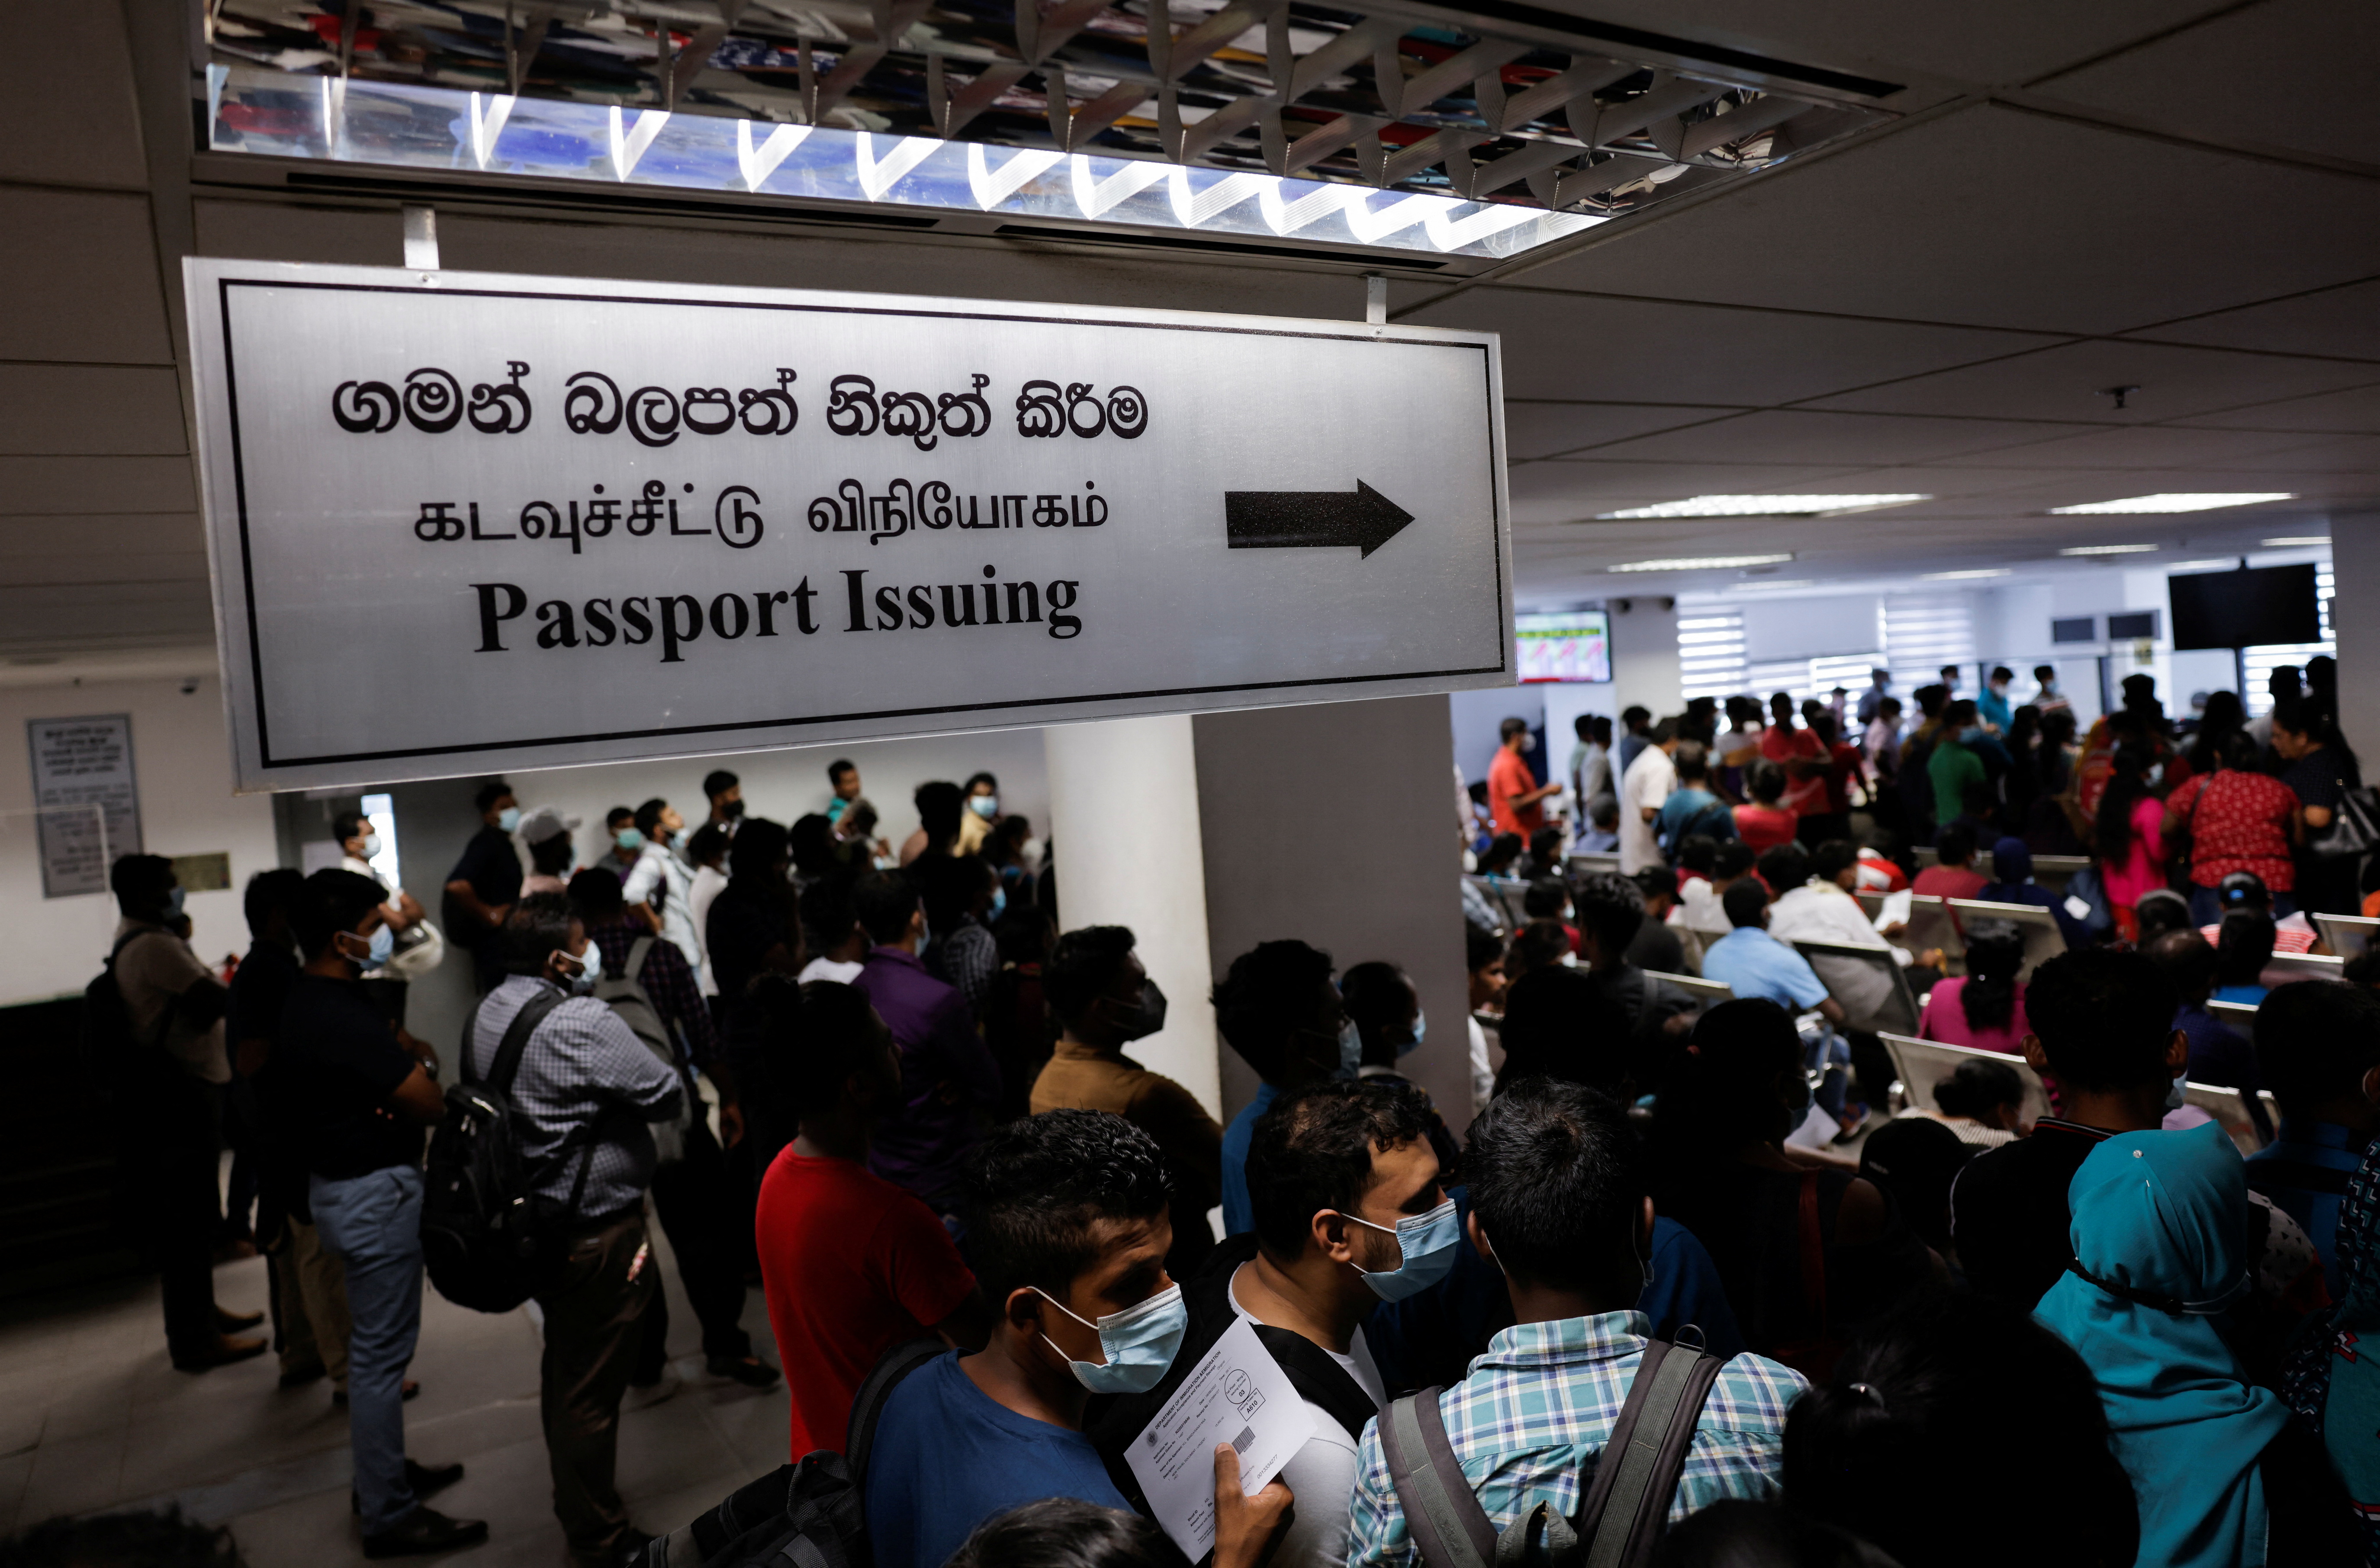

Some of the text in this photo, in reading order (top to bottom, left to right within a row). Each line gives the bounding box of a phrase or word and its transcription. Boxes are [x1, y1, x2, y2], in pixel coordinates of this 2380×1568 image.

[333, 361, 1148, 451] ගමන් බලපත් නිකුත් කිරීම
[415, 479, 1108, 554] கடவுச்சீட்டு விநியோகம்
[469, 565, 1081, 663] Passport Issuing
[1217, 1360, 1225, 1370] Original
[1231, 1378, 1246, 1396] Issuing Counter
[1238, 1388, 1245, 1397] 03
[1155, 1404, 1175, 1430] DEPARTMENT
[1180, 1375, 1200, 1401] IMMIGRATION
[1163, 1412, 1177, 1428] Application
[1177, 1395, 1191, 1412] Acceptance
[1195, 1376, 1207, 1390] Payment
[1206, 1365, 1216, 1377] Receipt
[1196, 1408, 1205, 1418] Receipt
[1239, 1402, 1248, 1411] Issuing
[1247, 1400, 1258, 1413] A610
[1153, 1446, 1165, 1460] Application
[1156, 1452, 1166, 1464] Applicant
[1177, 1462, 1185, 1471] TRAVEL
[1184, 1449, 1196, 1463] DOCUMENT
[1197, 1437, 1206, 1449] URGENT
[1163, 1465, 1175, 1479] Description
[1241, 1471, 1249, 1480] Rupees
[1190, 1516, 1200, 1527] Amount
